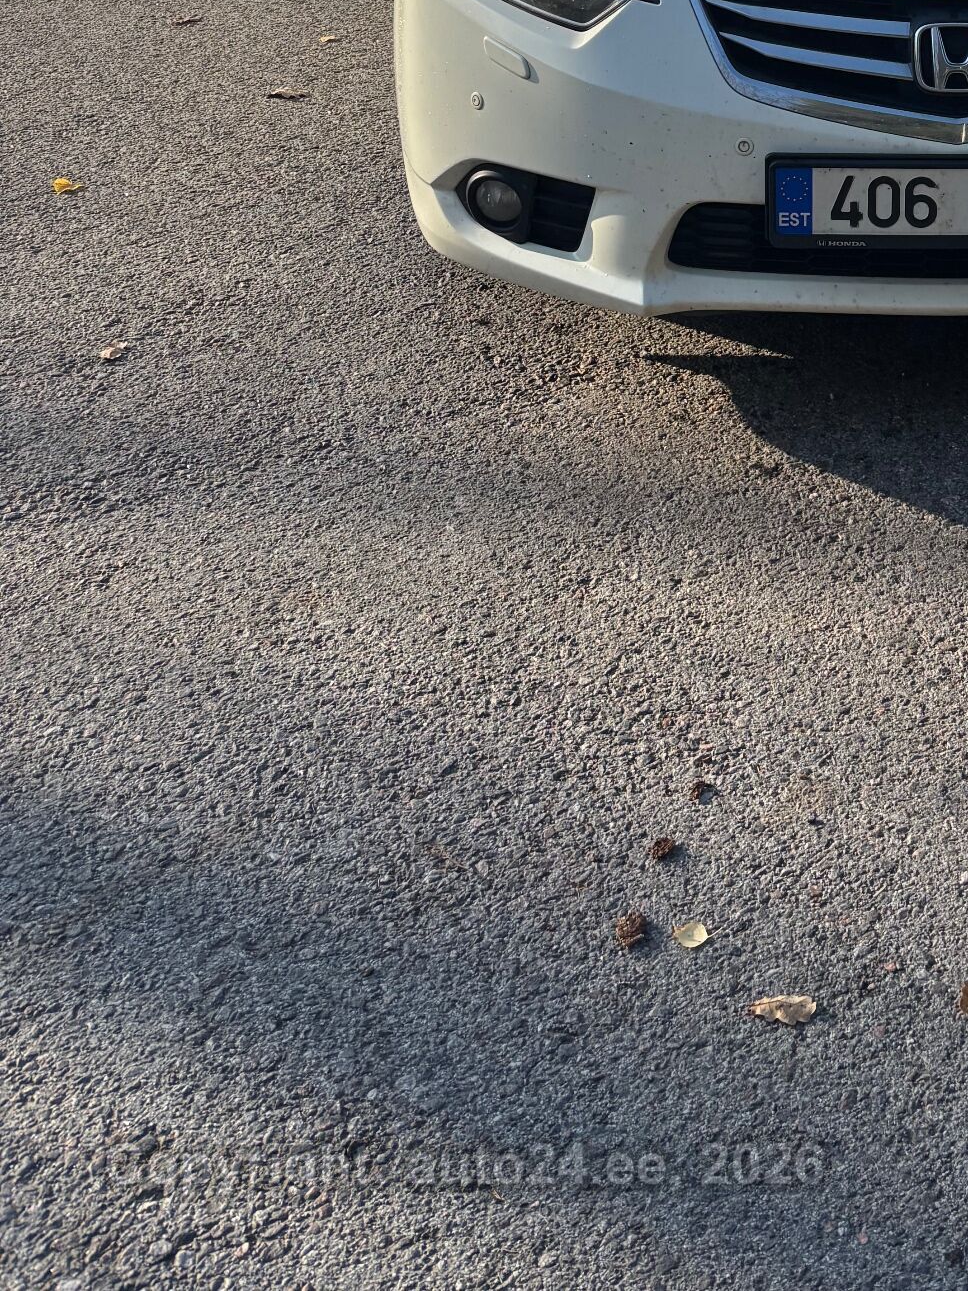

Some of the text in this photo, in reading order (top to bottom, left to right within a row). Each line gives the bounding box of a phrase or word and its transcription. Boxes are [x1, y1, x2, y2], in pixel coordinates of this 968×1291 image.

[830, 175, 939, 229] 406
[778, 212, 811, 228] EST
[828, 240, 867, 248] HONDA
